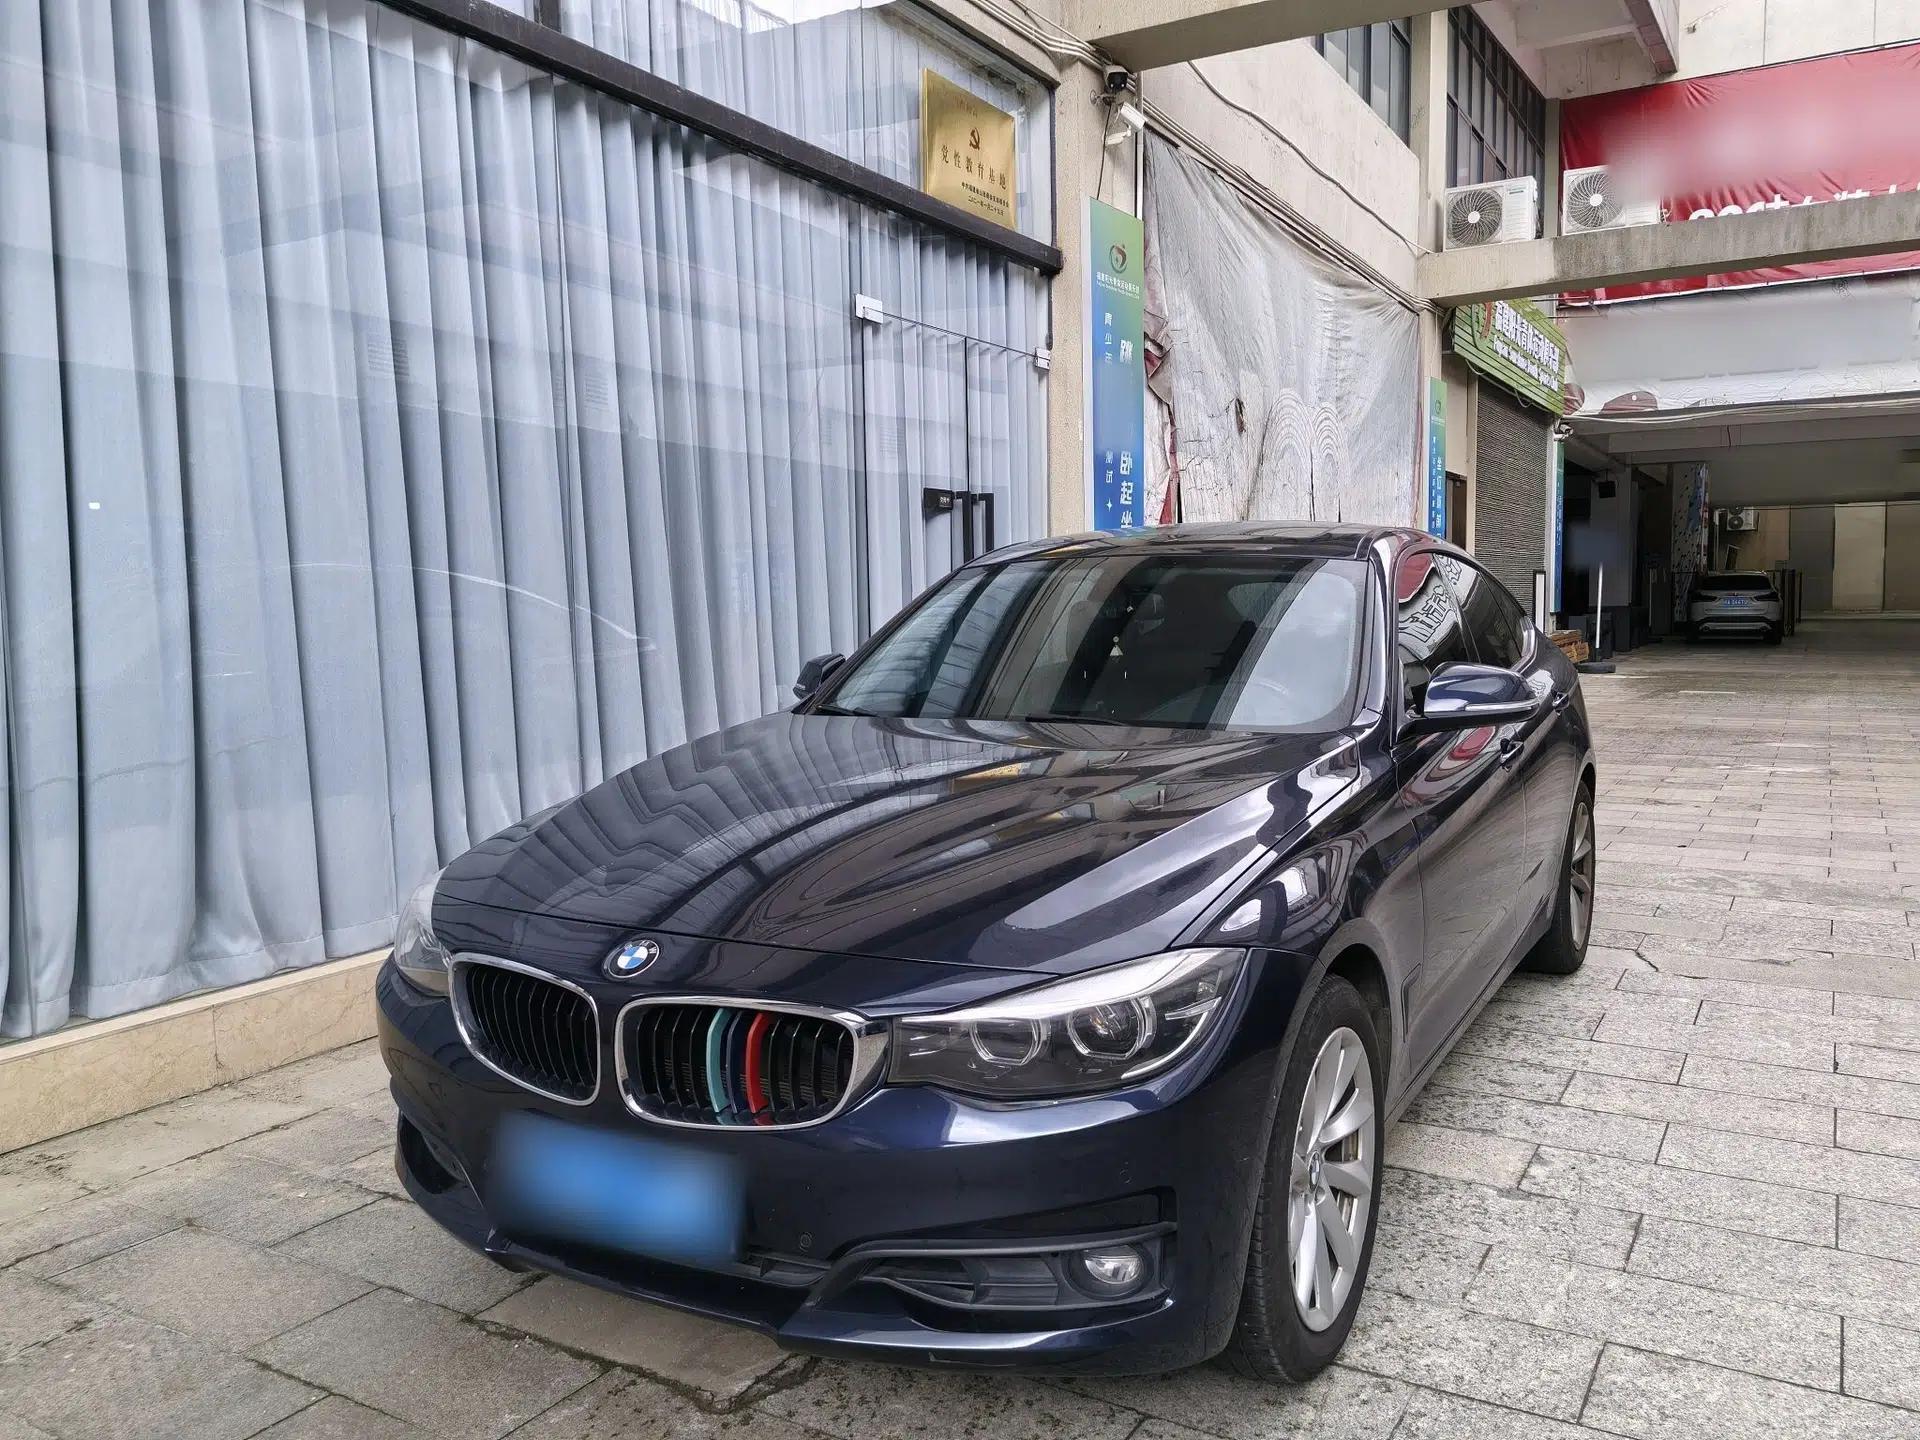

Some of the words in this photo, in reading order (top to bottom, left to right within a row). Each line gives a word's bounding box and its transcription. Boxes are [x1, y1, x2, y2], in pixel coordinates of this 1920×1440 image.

[941, 144, 1006, 190] 党性教育基地
